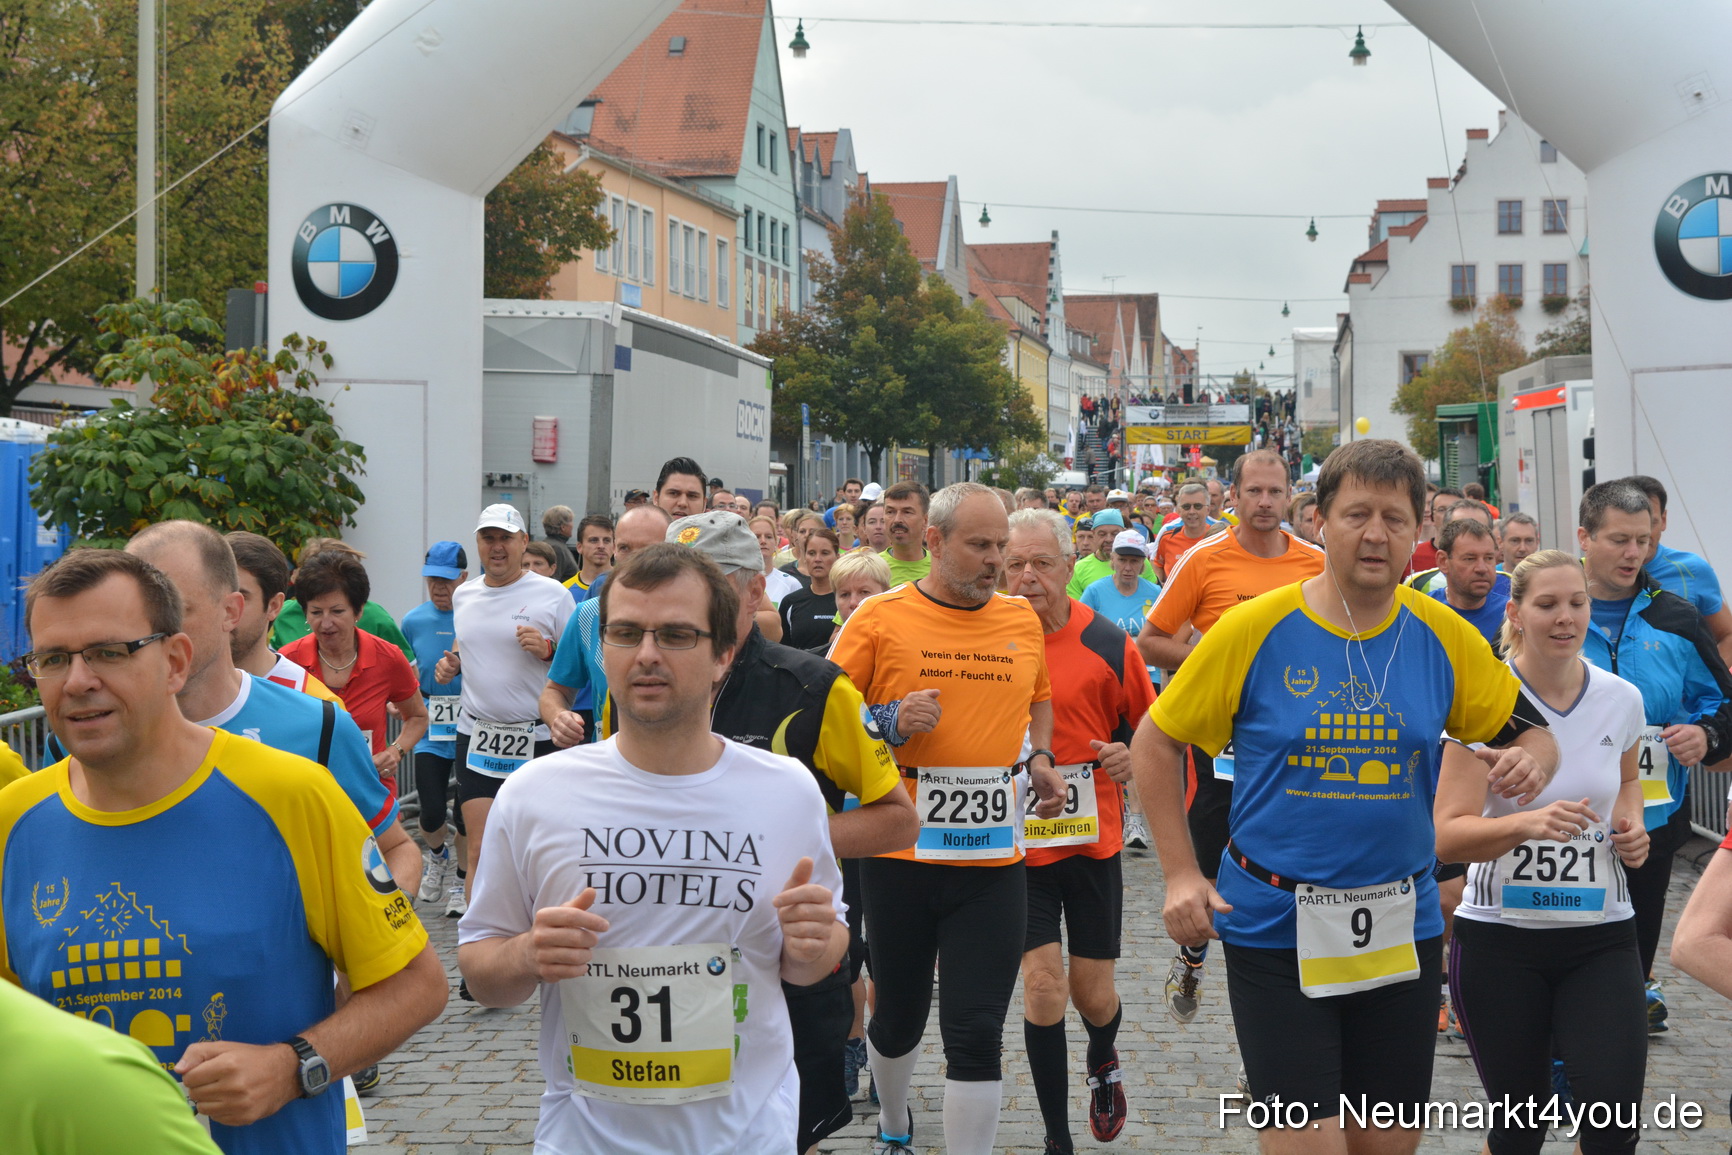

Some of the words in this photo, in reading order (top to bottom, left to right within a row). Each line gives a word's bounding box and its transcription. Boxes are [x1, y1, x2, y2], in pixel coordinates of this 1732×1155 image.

[299, 205, 391, 245] BMW
[1166, 429, 1209, 440] START
[511, 613, 530, 622] Lightning
[921, 650, 952, 660] Verein
[954, 652, 970, 661] der
[973, 653, 1014, 665] Notärzte
[919, 668, 952, 678] Altdorf
[961, 670, 994, 681] Feucht
[996, 673, 1013, 683] e.V.
[476, 730, 529, 757] 2422
[1305, 745, 1371, 754] 21.September
[1374, 746, 1397, 754] 2014
[483, 759, 515, 771] Herbert
[920, 774, 953, 785] PARTL
[956, 776, 1000, 785] Neumarkt
[1285, 788, 1411, 800] www.stadtlauf-neumarkt.de
[927, 788, 1008, 824] 2239
[1024, 822, 1091, 836] einz-Jürgen
[943, 832, 991, 846] Norbert
[1512, 844, 1596, 883] 2521
[45, 884, 56, 894] 15
[583, 871, 756, 913] HOTELS
[1298, 894, 1341, 906] PARTL
[1344, 887, 1398, 904] Neumarkt
[39, 897, 61, 909] Jahre
[1532, 891, 1582, 907] Sabine
[1350, 907, 1373, 949] 9
[585, 963, 615, 978] RTL
[618, 962, 700, 978] Neumarkt
[57, 990, 145, 1008] 21.September
[149, 987, 183, 1000] 2014
[610, 985, 673, 1044] 31
[611, 1058, 681, 1082] Stefan
